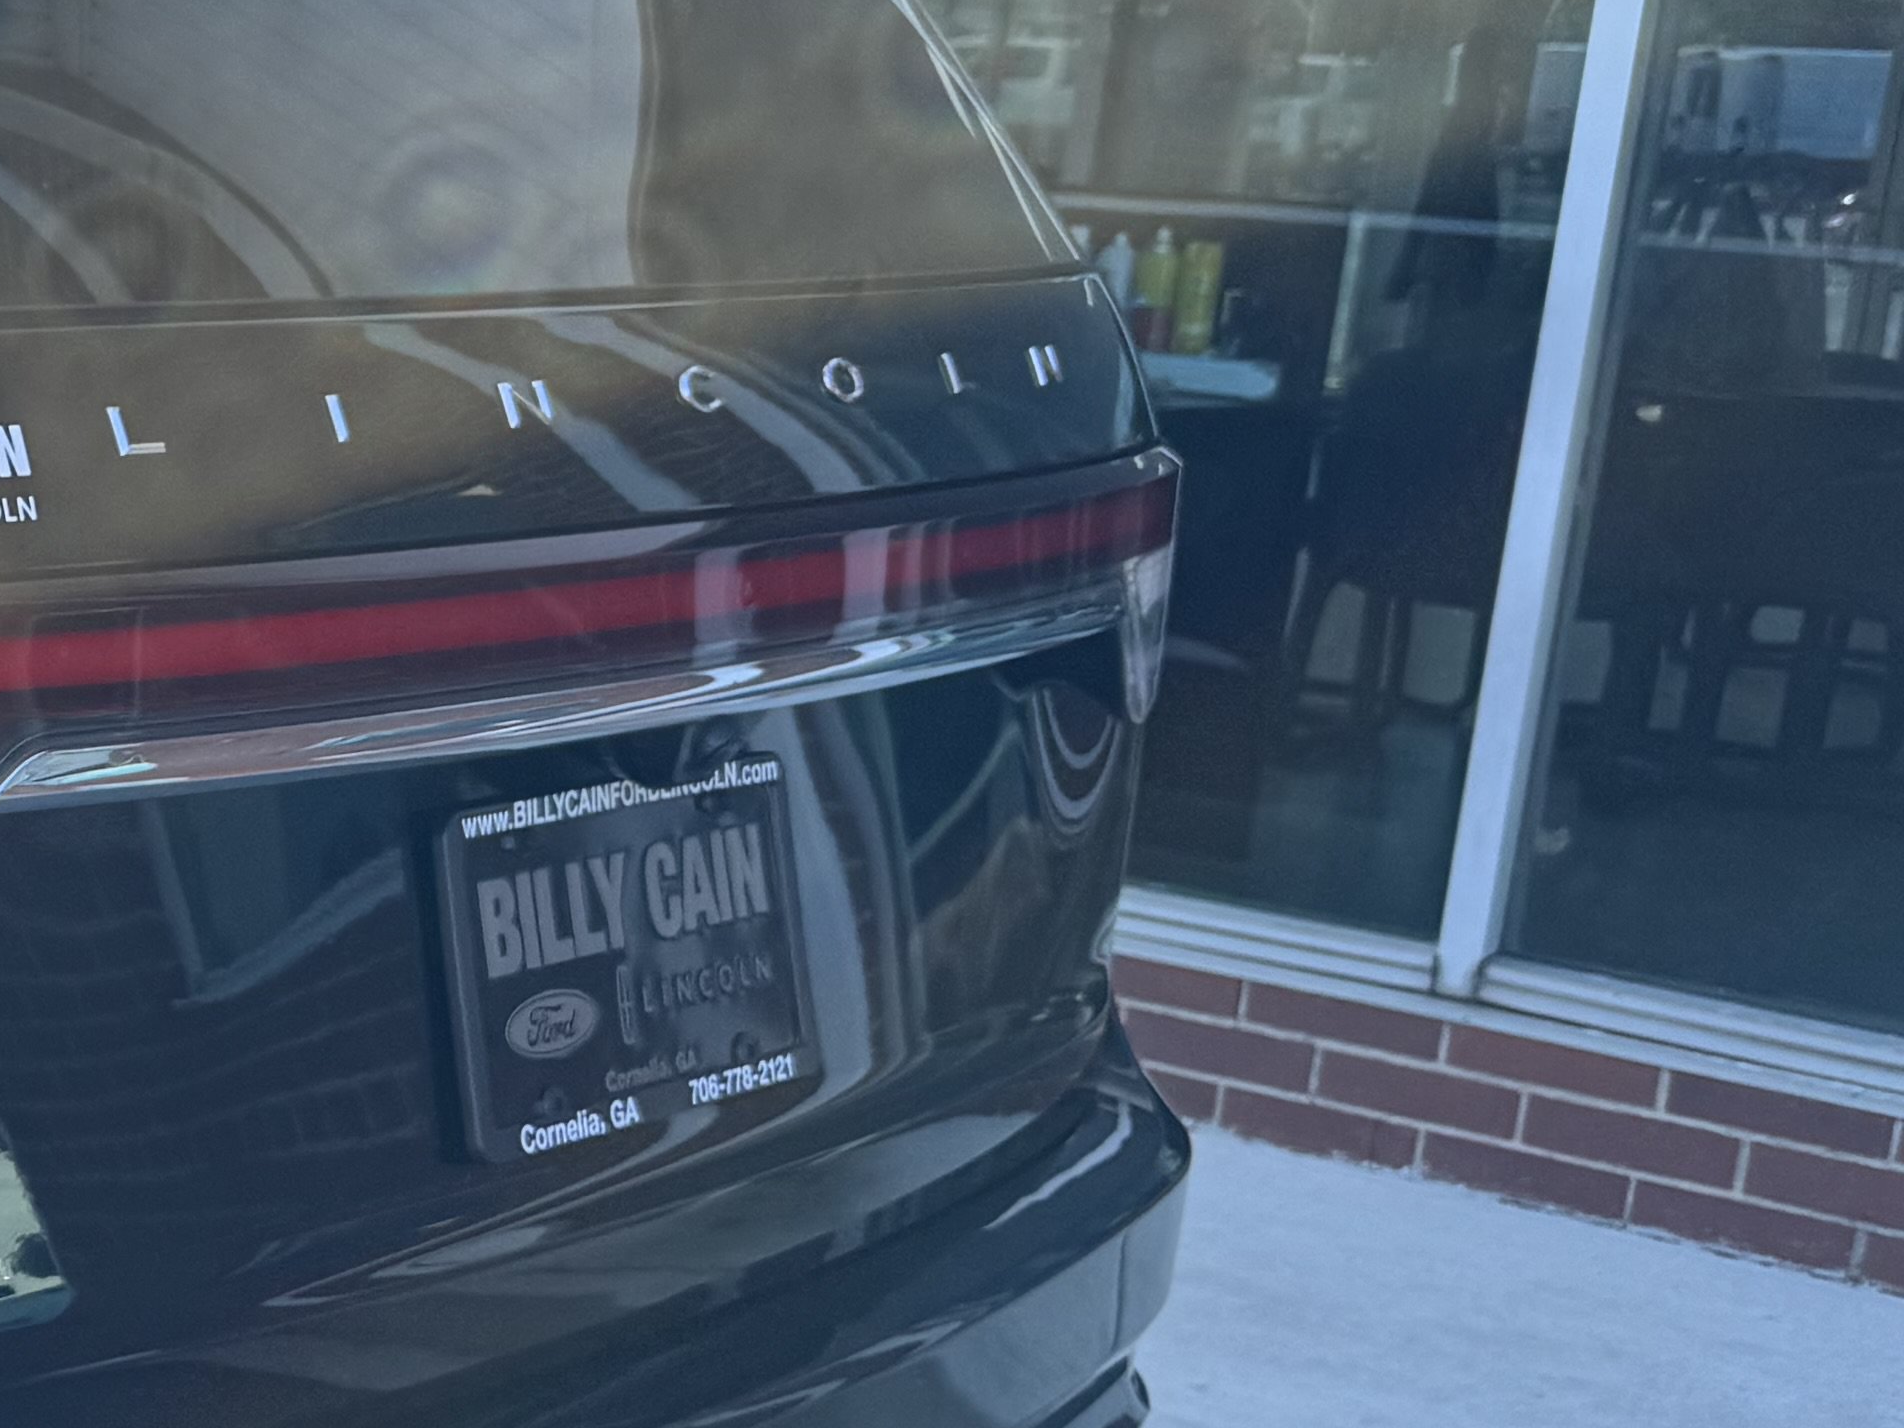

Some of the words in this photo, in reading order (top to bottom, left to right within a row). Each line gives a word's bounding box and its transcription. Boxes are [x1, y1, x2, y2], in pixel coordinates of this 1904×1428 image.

[106, 344, 1064, 455] LINCOLN
[477, 851, 625, 979] BILLY
[644, 822, 770, 939] CAIN
[643, 956, 772, 1013] LINCOLN
[688, 1052, 797, 1105] 706-778-2121
[520, 1109, 607, 1155] Cornelia,
[610, 1095, 641, 1130] GA
